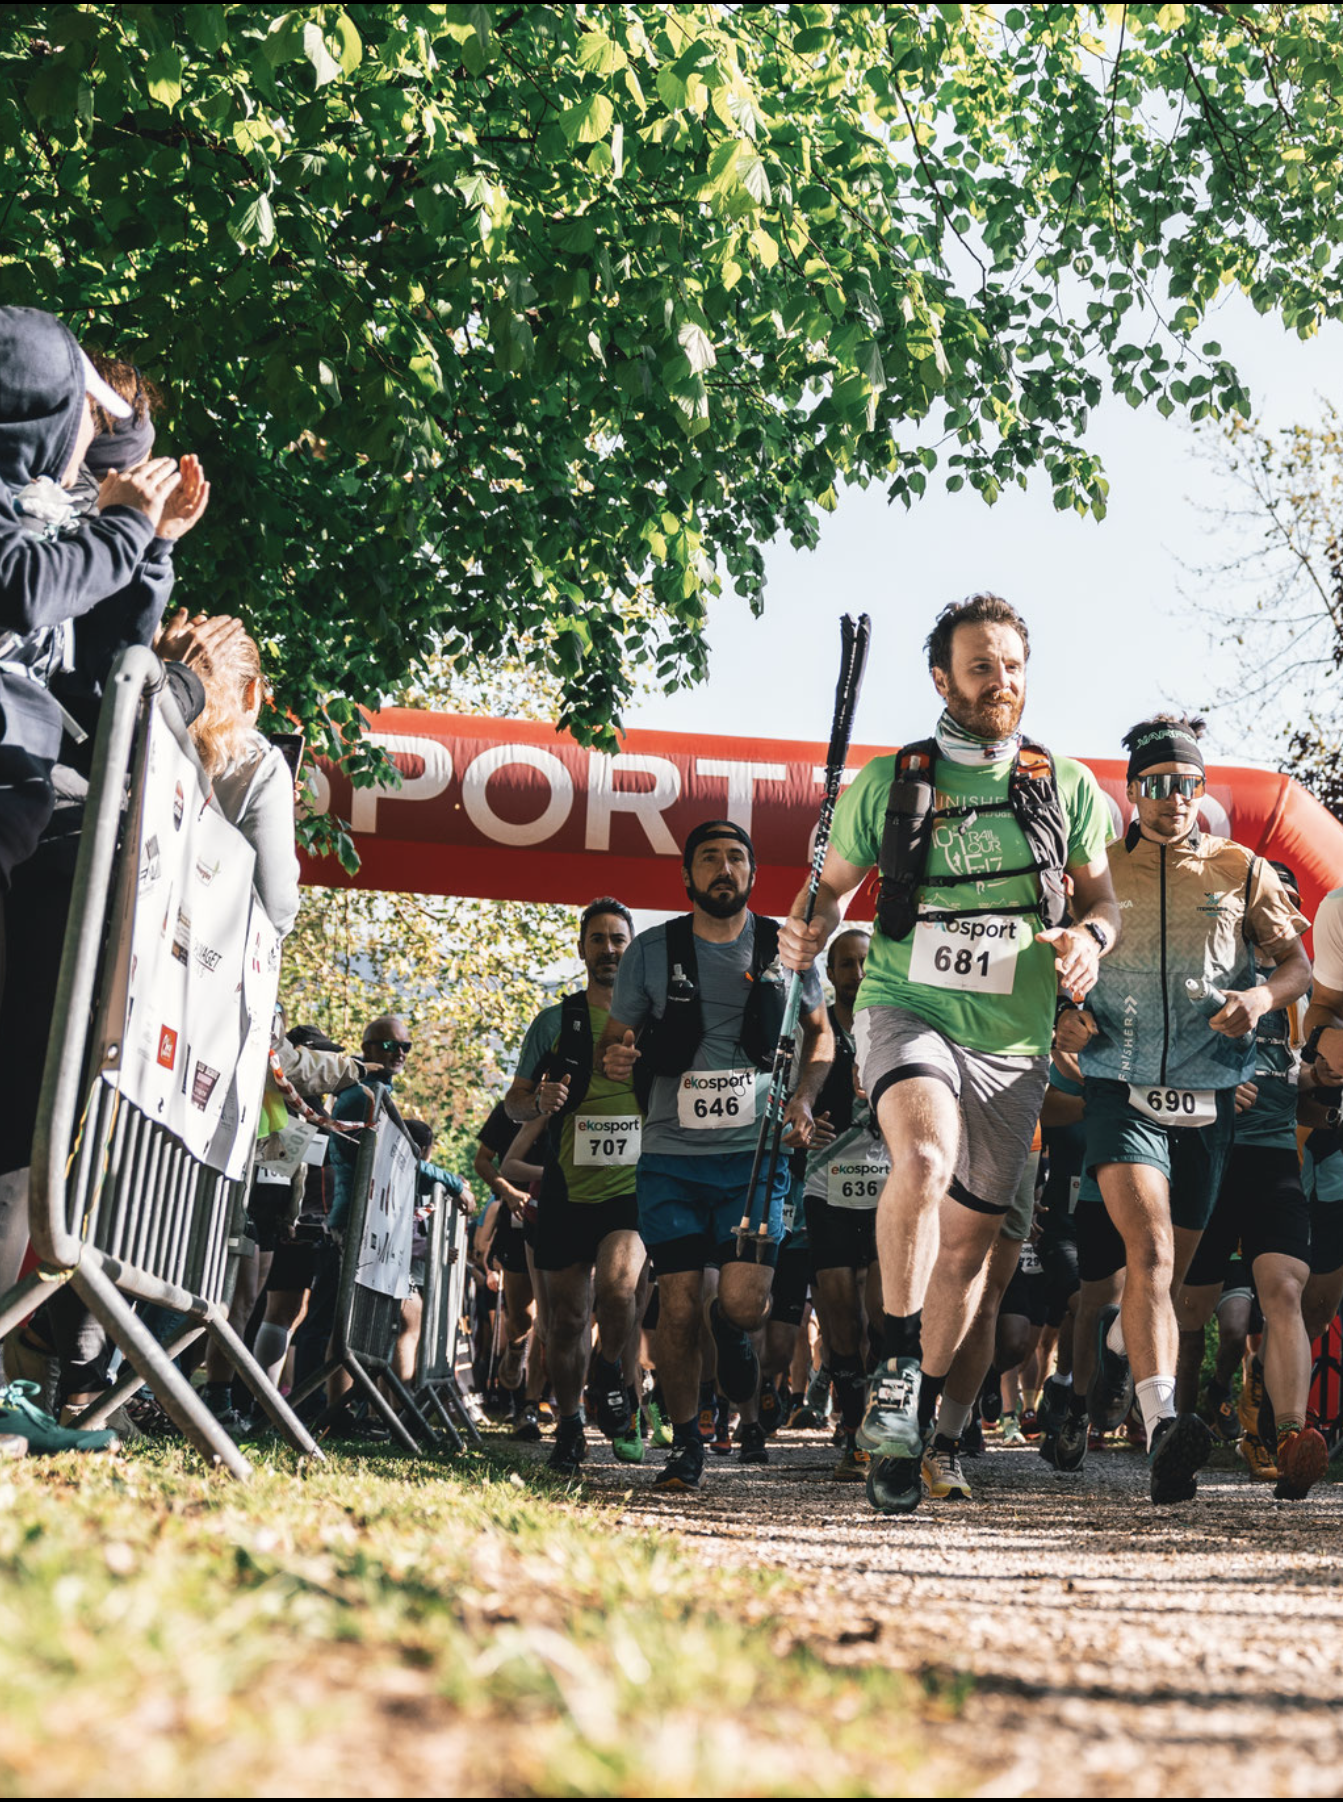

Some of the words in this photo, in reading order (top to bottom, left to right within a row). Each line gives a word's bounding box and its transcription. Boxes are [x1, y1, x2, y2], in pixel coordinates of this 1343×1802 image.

[934, 946, 990, 977] 681
[683, 1072, 752, 1092] ekosport
[694, 1096, 740, 1118] 646
[1146, 1090, 1196, 1114] 690
[578, 1118, 640, 1134] ekosport
[589, 1139, 628, 1156] 707
[831, 1164, 890, 1176] ekosport
[842, 1181, 878, 1197] 636
